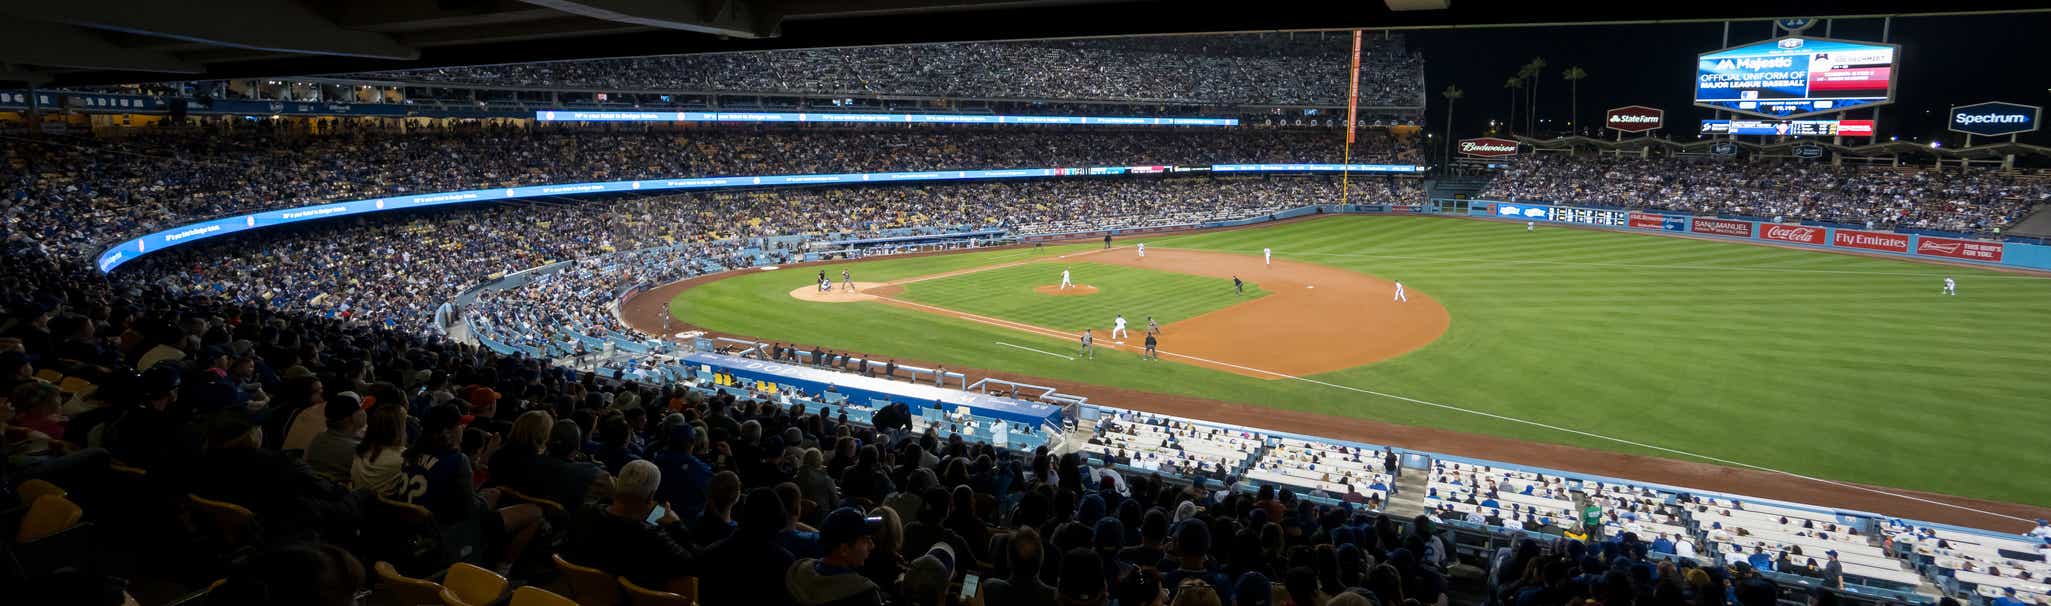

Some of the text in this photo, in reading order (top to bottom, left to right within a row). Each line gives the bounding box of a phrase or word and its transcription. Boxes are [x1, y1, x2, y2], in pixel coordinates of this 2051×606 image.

[1736, 57, 1792, 71] Majestic
[1700, 71, 1805, 82] OFFICIAL UNIFORM OF
[1700, 79, 1804, 89] MAJOR LEAGUE BASEBALL
[1955, 113, 2024, 126] Spectrum
[1461, 141, 1516, 152] Budweiser
[1695, 220, 1748, 231] SAN MANUEL
[1836, 233, 1854, 245] Fly
[1856, 235, 1907, 249] Emirates
